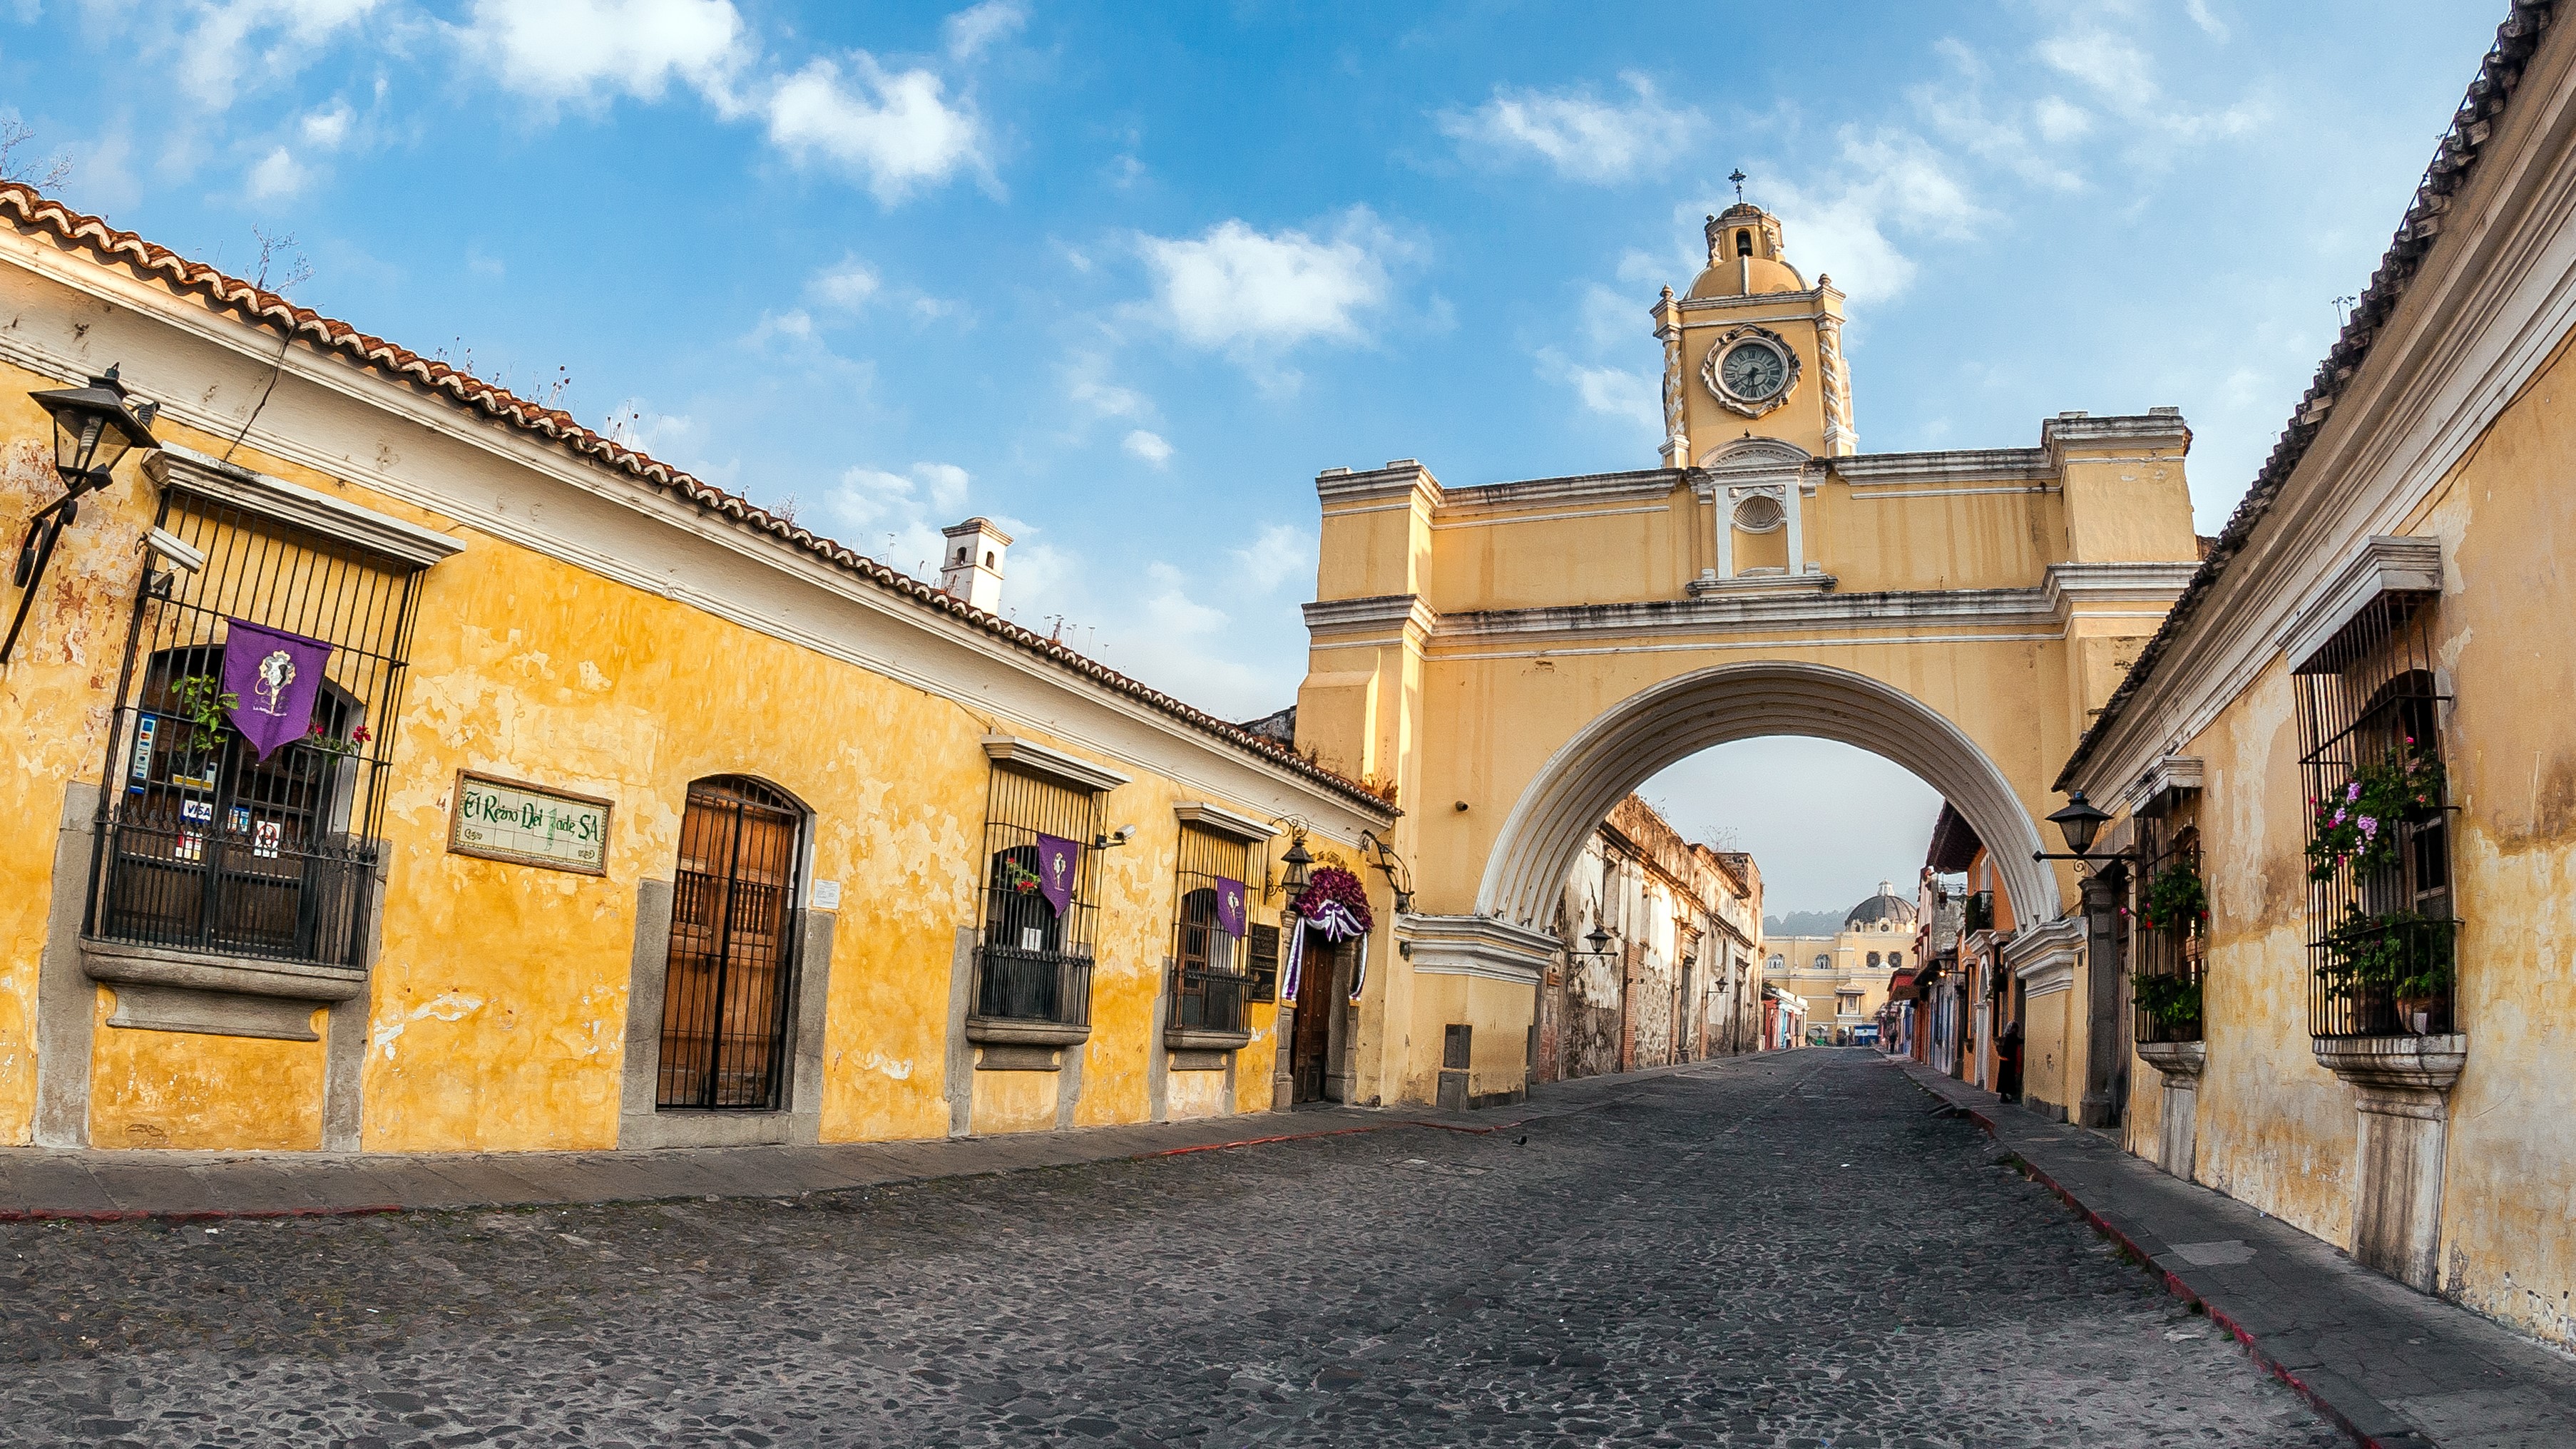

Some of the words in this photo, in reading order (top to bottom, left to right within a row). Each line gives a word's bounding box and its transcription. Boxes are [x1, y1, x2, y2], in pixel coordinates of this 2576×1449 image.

[187, 803, 211, 818] VISA
[464, 791, 480, 819] El
[483, 795, 518, 824] Reino
[520, 802, 543, 829] Del
[578, 814, 601, 842] SA
